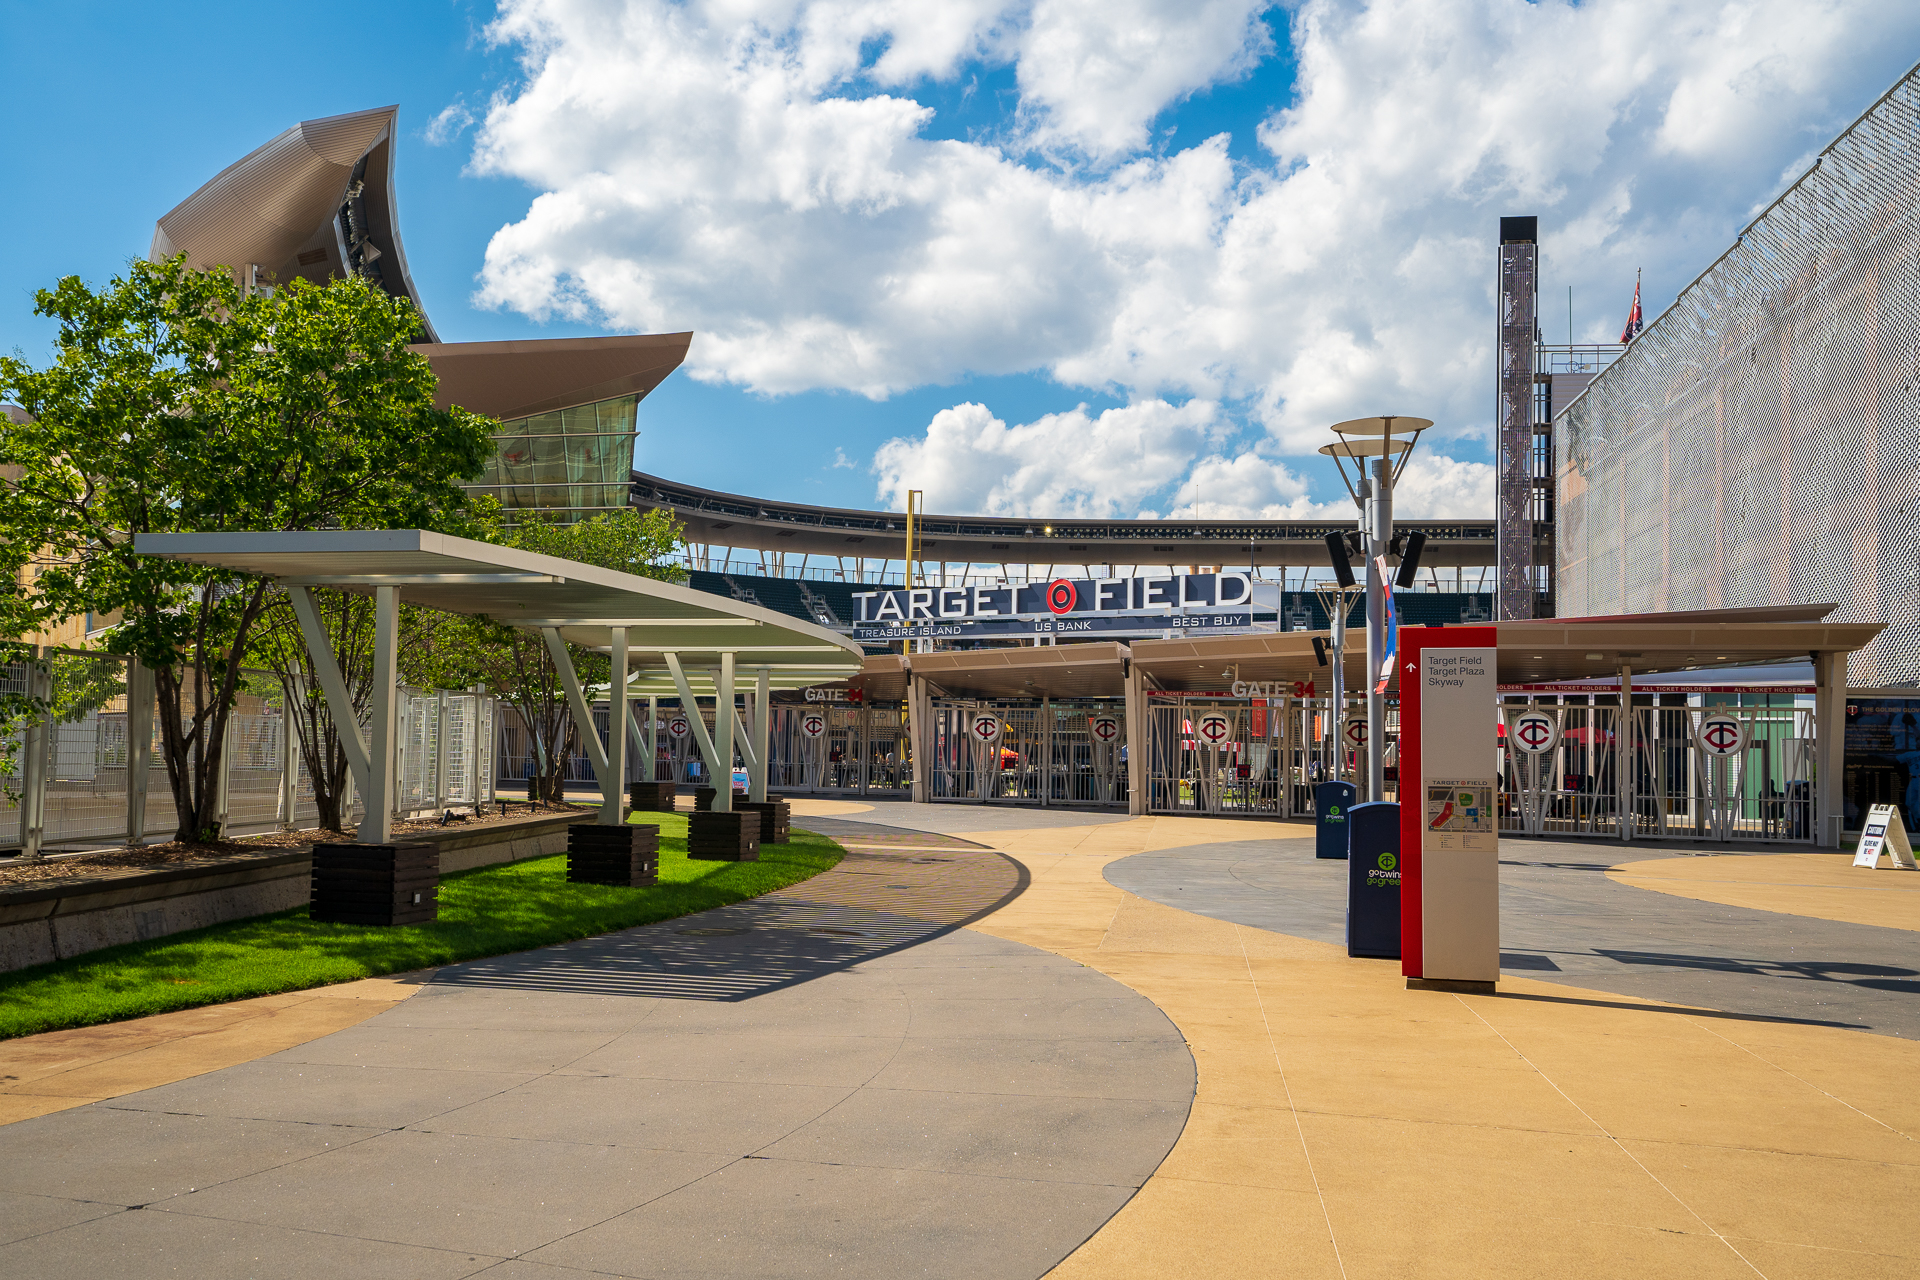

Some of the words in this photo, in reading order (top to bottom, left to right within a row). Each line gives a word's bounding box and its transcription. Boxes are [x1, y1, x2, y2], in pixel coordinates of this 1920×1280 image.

[852, 583, 1029, 621] TARGET
[1095, 572, 1252, 611] FIELD
[1035, 622, 1052, 632] US
[1057, 620, 1091, 631] BANK
[1172, 616, 1208, 627] BEST
[1213, 615, 1243, 626] BUY
[859, 627, 916, 638] TREASURE
[919, 625, 962, 636] ISLAND
[1428, 656, 1457, 667] Target
[1459, 656, 1482, 665] Field
[1428, 667, 1457, 677] Target
[1459, 667, 1485, 676] Plaza
[1428, 677, 1465, 688] Skyway
[804, 687, 844, 702] GATE
[847, 688, 863, 702] 34
[1231, 680, 1287, 698] GATE
[1293, 680, 1316, 699] 34
[1566, 780, 1578, 789] 34
